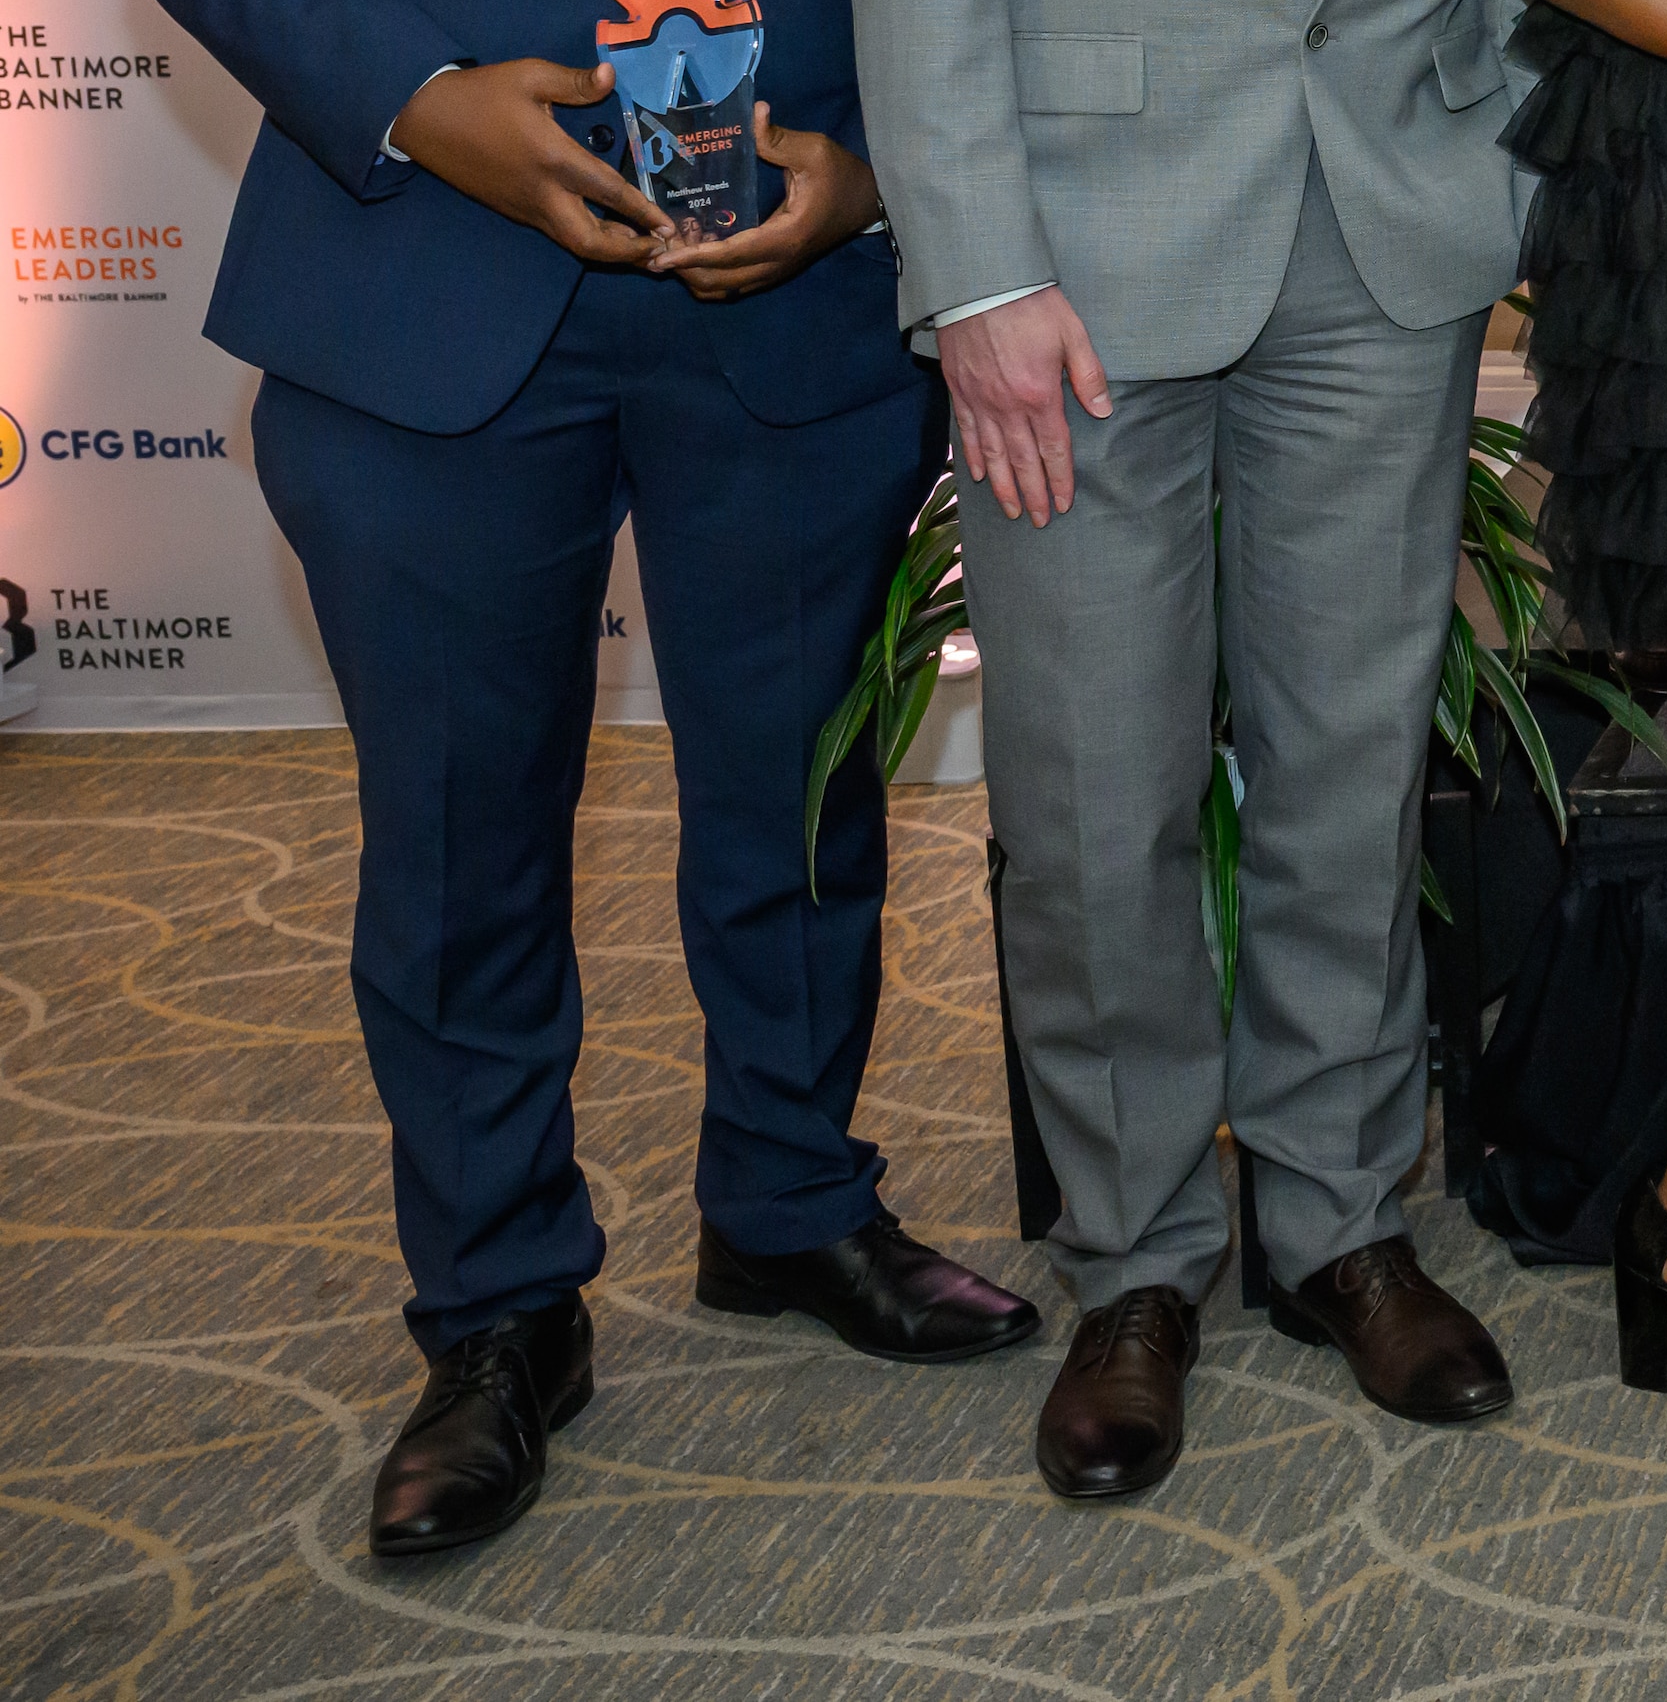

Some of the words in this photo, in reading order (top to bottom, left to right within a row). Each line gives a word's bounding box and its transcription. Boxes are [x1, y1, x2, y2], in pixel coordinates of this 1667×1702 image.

[677, 125, 742, 145] EMERGING
[679, 139, 733, 158] LEADERS
[667, 186, 702, 199] Matthew
[688, 197, 711, 209] 2024
[11, 226, 183, 249] EMERGING
[15, 257, 157, 280] LEADERS
[19, 296, 28, 304] by
[35, 294, 53, 302] THE
[59, 293, 119, 301] BALTIMORE
[124, 293, 166, 301] BANNER
[42, 430, 124, 460] CFG
[134, 429, 227, 458] Bank
[52, 589, 109, 610] THE
[56, 617, 231, 639] BALTIMORE
[59, 648, 184, 669] BANNER
